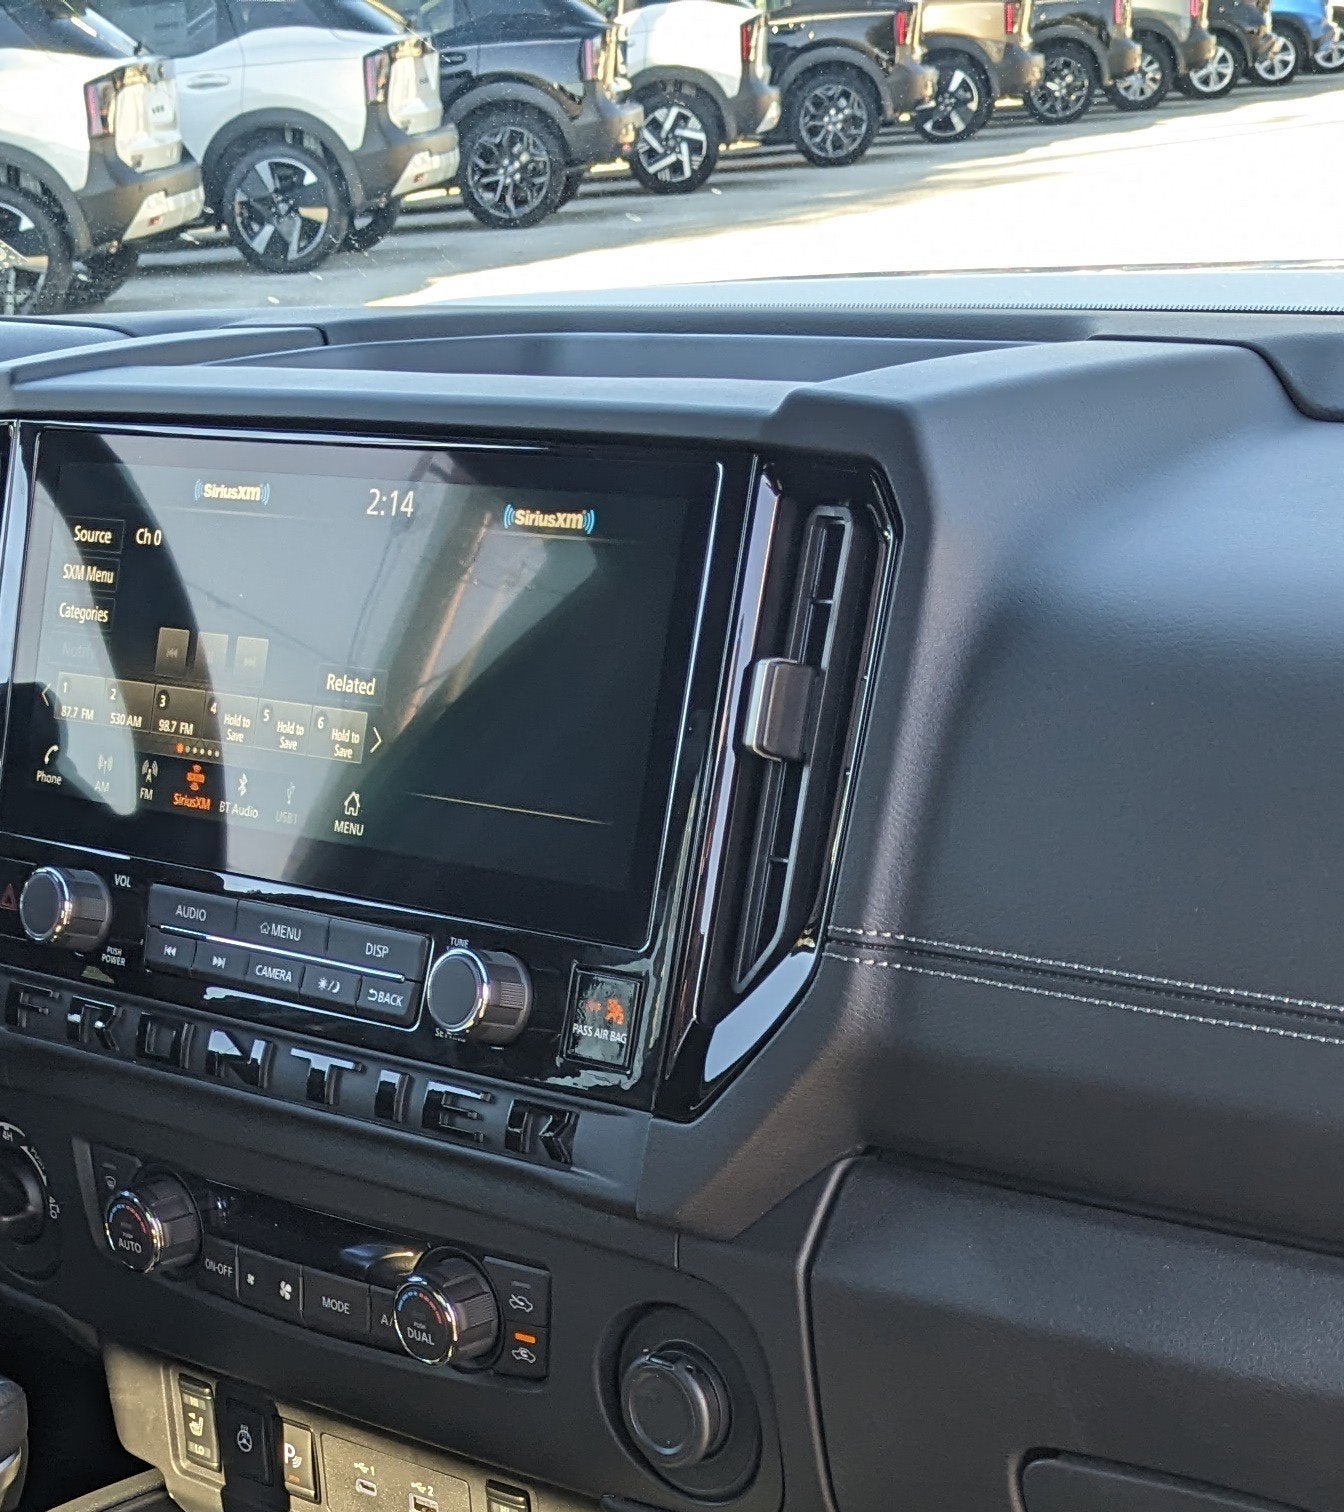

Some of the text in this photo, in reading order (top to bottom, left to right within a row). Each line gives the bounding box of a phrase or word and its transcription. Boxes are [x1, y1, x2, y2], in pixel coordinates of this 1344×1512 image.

[366, 488, 415, 517] 2:14
[74, 525, 112, 545] Source
[135, 528, 162, 546] Ch 0
[62, 563, 114, 585] SXM Menu
[59, 603, 109, 624] Categories
[326, 673, 376, 696] Related
[159, 694, 166, 708] 3
[210, 702, 217, 715] 4
[81, 708, 94, 721] FM
[126, 714, 142, 728] AM
[223, 713, 251, 728] Hold to
[263, 709, 270, 722] 5
[317, 716, 325, 729] 6
[179, 722, 194, 736] FM
[226, 728, 244, 743] Save
[276, 721, 305, 736] Hold to
[331, 728, 360, 744] Hold to
[279, 736, 298, 751] Save
[334, 744, 353, 759] Save
[36, 770, 62, 786] Phone
[94, 780, 110, 793] AM
[140, 787, 154, 801] FM
[219, 801, 259, 819] BT Audio
[334, 819, 365, 837] MENU
[114, 873, 132, 889] VOL
[175, 904, 207, 922] AUDIO
[271, 923, 302, 942] MENU
[365, 942, 389, 959] DISP
[255, 964, 293, 983] CAMERA
[377, 991, 404, 1008] BACK
[572, 1022, 628, 1045] PASS AIR BAG
[5, 980, 581, 1164] FRONTIER
[118, 1238, 142, 1254] AUTO
[205, 1258, 233, 1278] ON-OFF
[321, 1296, 351, 1315] MODE
[406, 1326, 435, 1346] DUAL
[427, 1485, 435, 1497] 2
